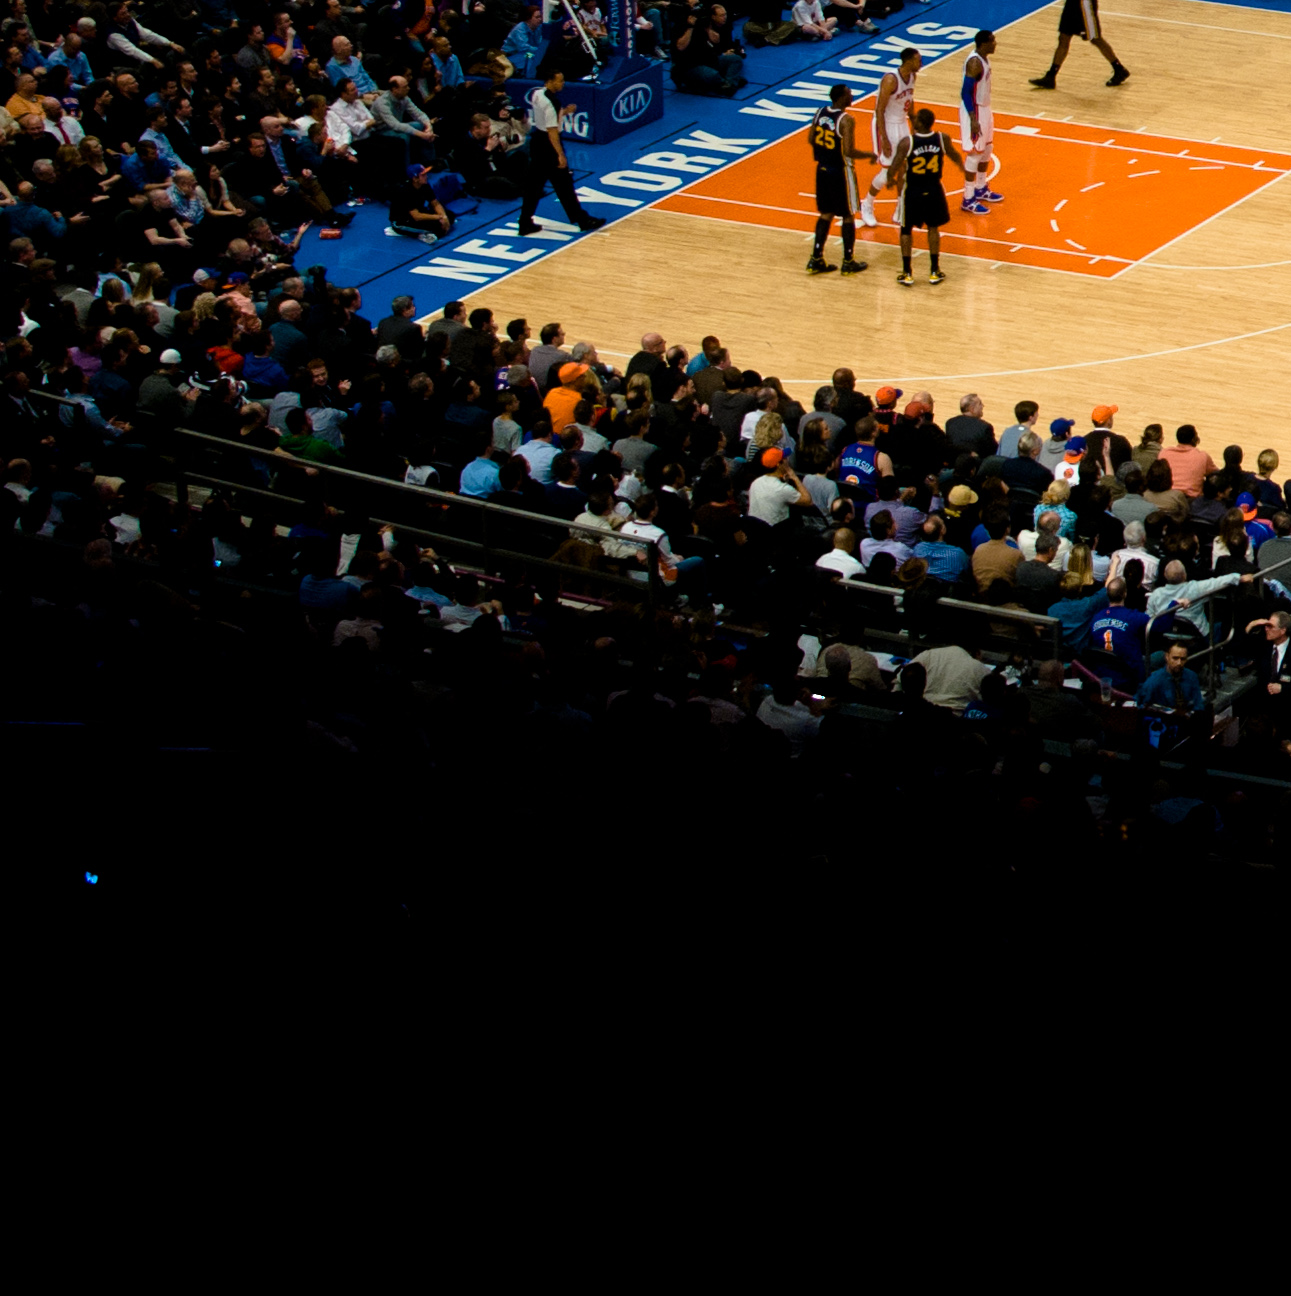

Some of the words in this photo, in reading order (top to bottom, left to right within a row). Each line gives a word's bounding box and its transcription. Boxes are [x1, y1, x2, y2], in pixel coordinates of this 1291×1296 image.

[619, 90, 645, 118] KIA
[814, 125, 836, 150] 25
[408, 214, 582, 285] NEW
[555, 128, 769, 208] YORK
[739, 21, 981, 122] KNICKS
[911, 154, 940, 175] 24
